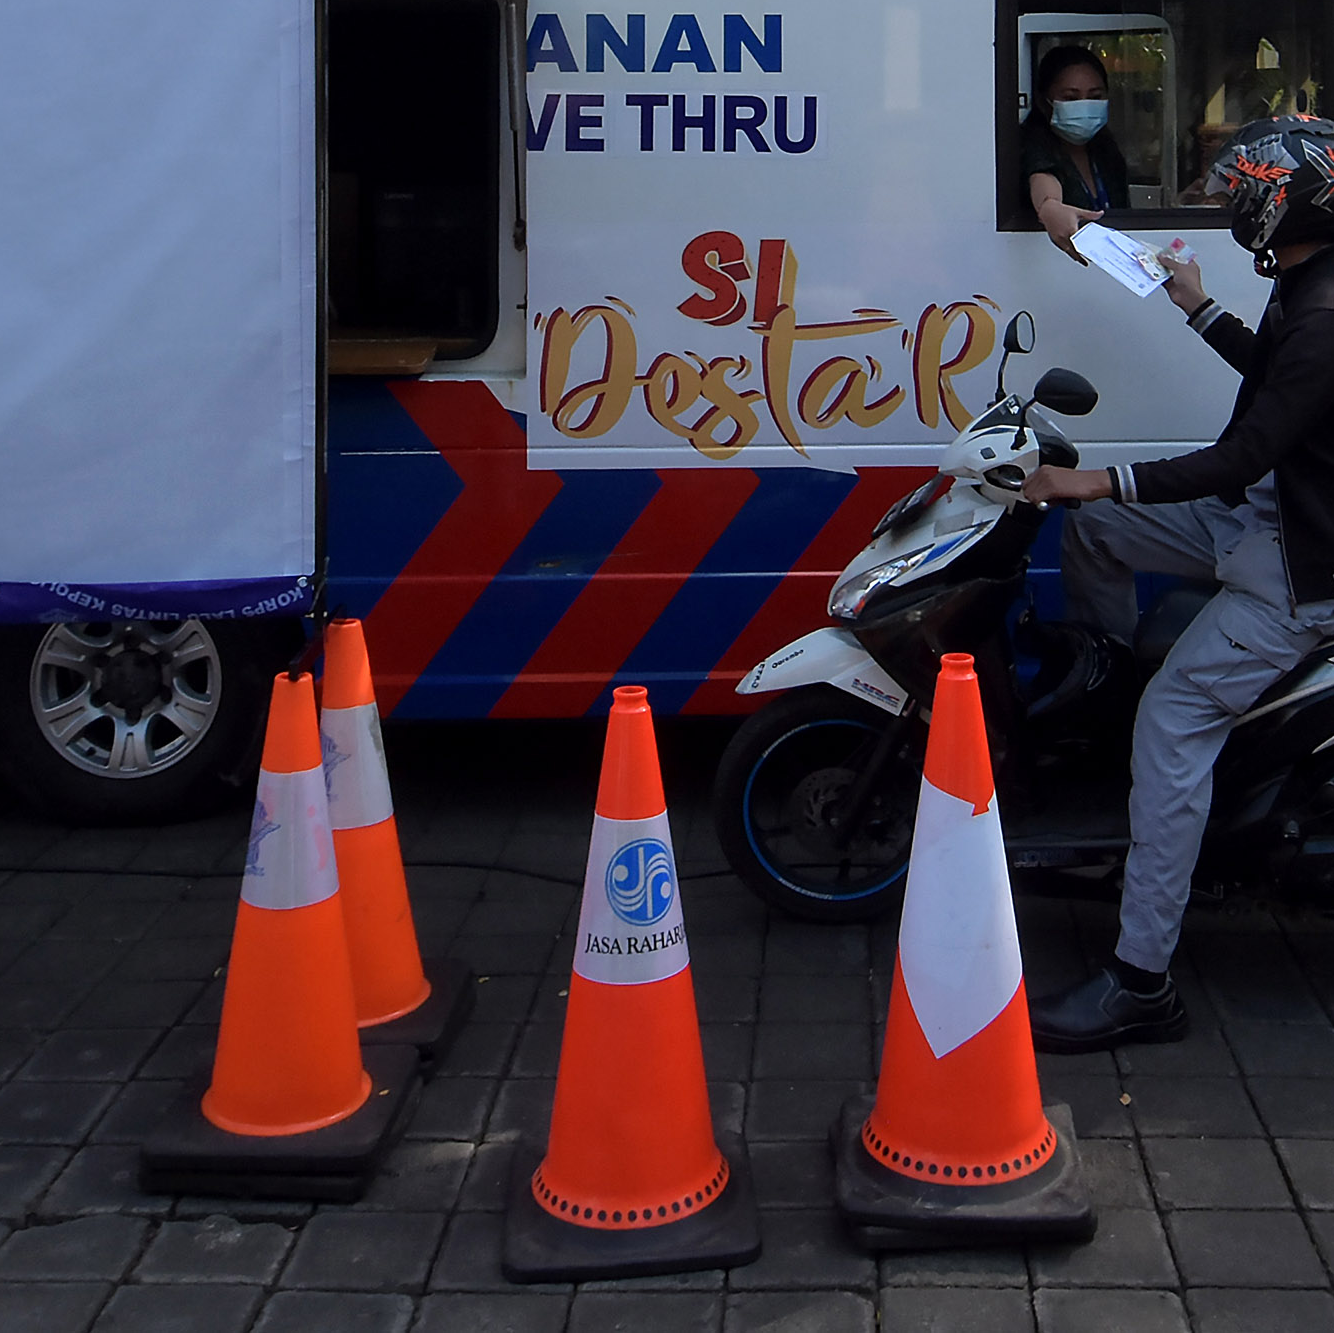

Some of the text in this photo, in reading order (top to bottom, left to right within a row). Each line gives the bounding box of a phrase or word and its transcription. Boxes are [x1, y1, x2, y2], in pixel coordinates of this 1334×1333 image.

[625, 93, 818, 154] THRU
[677, 230, 797, 327] SI
[241, 585, 305, 617] KORPS
[584, 932, 623, 955] JASA
